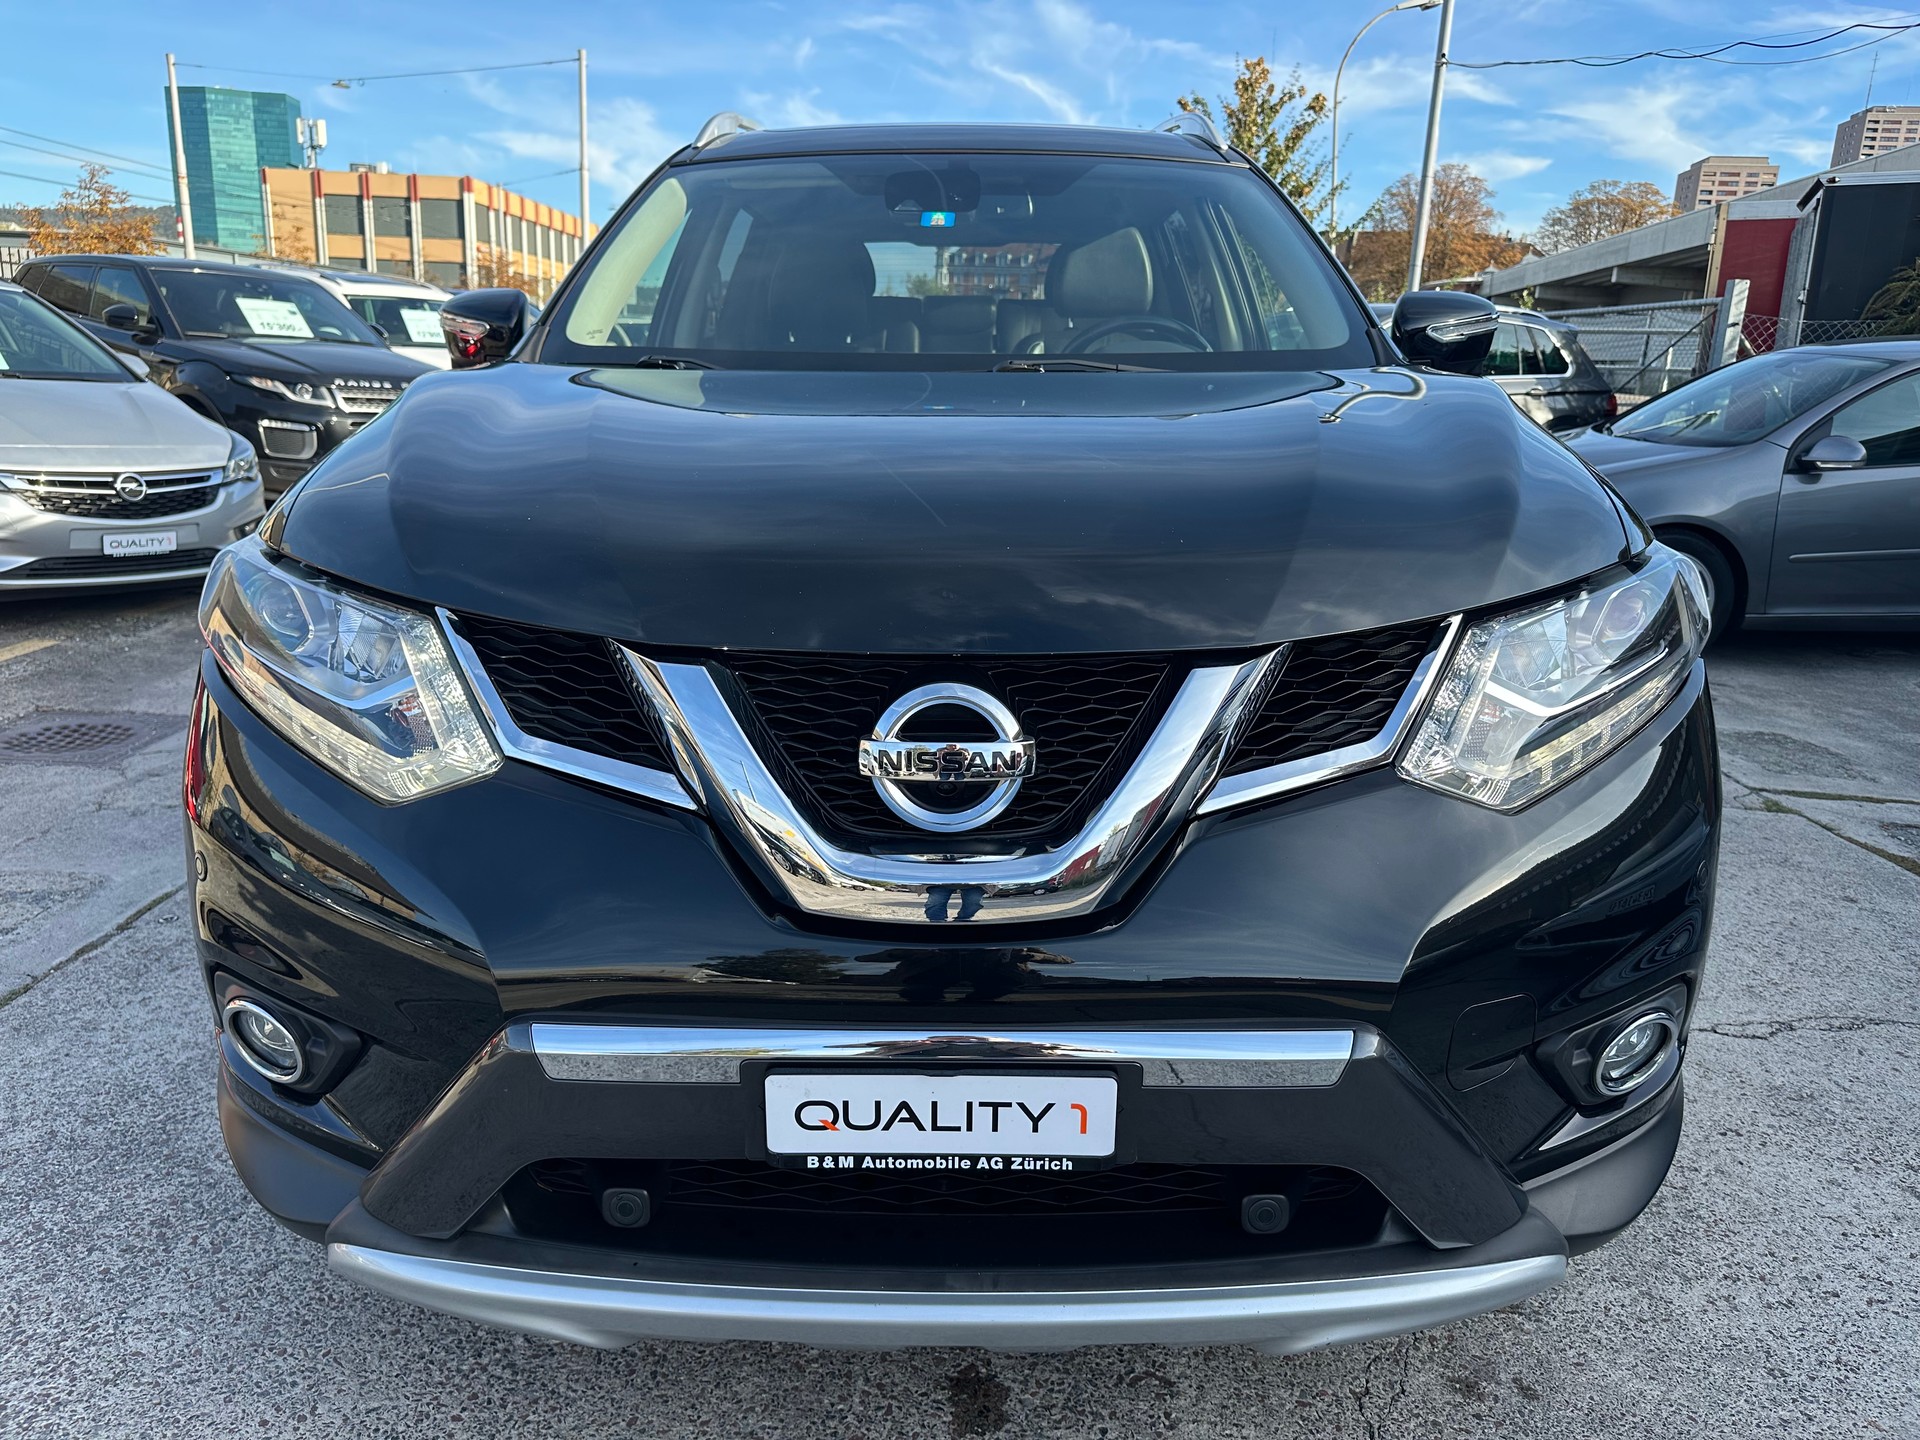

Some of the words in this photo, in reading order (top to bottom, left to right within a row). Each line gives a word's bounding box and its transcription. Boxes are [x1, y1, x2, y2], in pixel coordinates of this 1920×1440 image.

[334, 378, 392, 389] RANGE
[109, 537, 165, 549] QUALITY
[877, 749, 1017, 774] NISSAN
[794, 1099, 1057, 1134] QUALITY
[1070, 1103, 1088, 1135] 1
[861, 1156, 971, 1169] Automobile
[976, 1156, 1003, 1170] AG
[1010, 1157, 1073, 1171] Zürich
